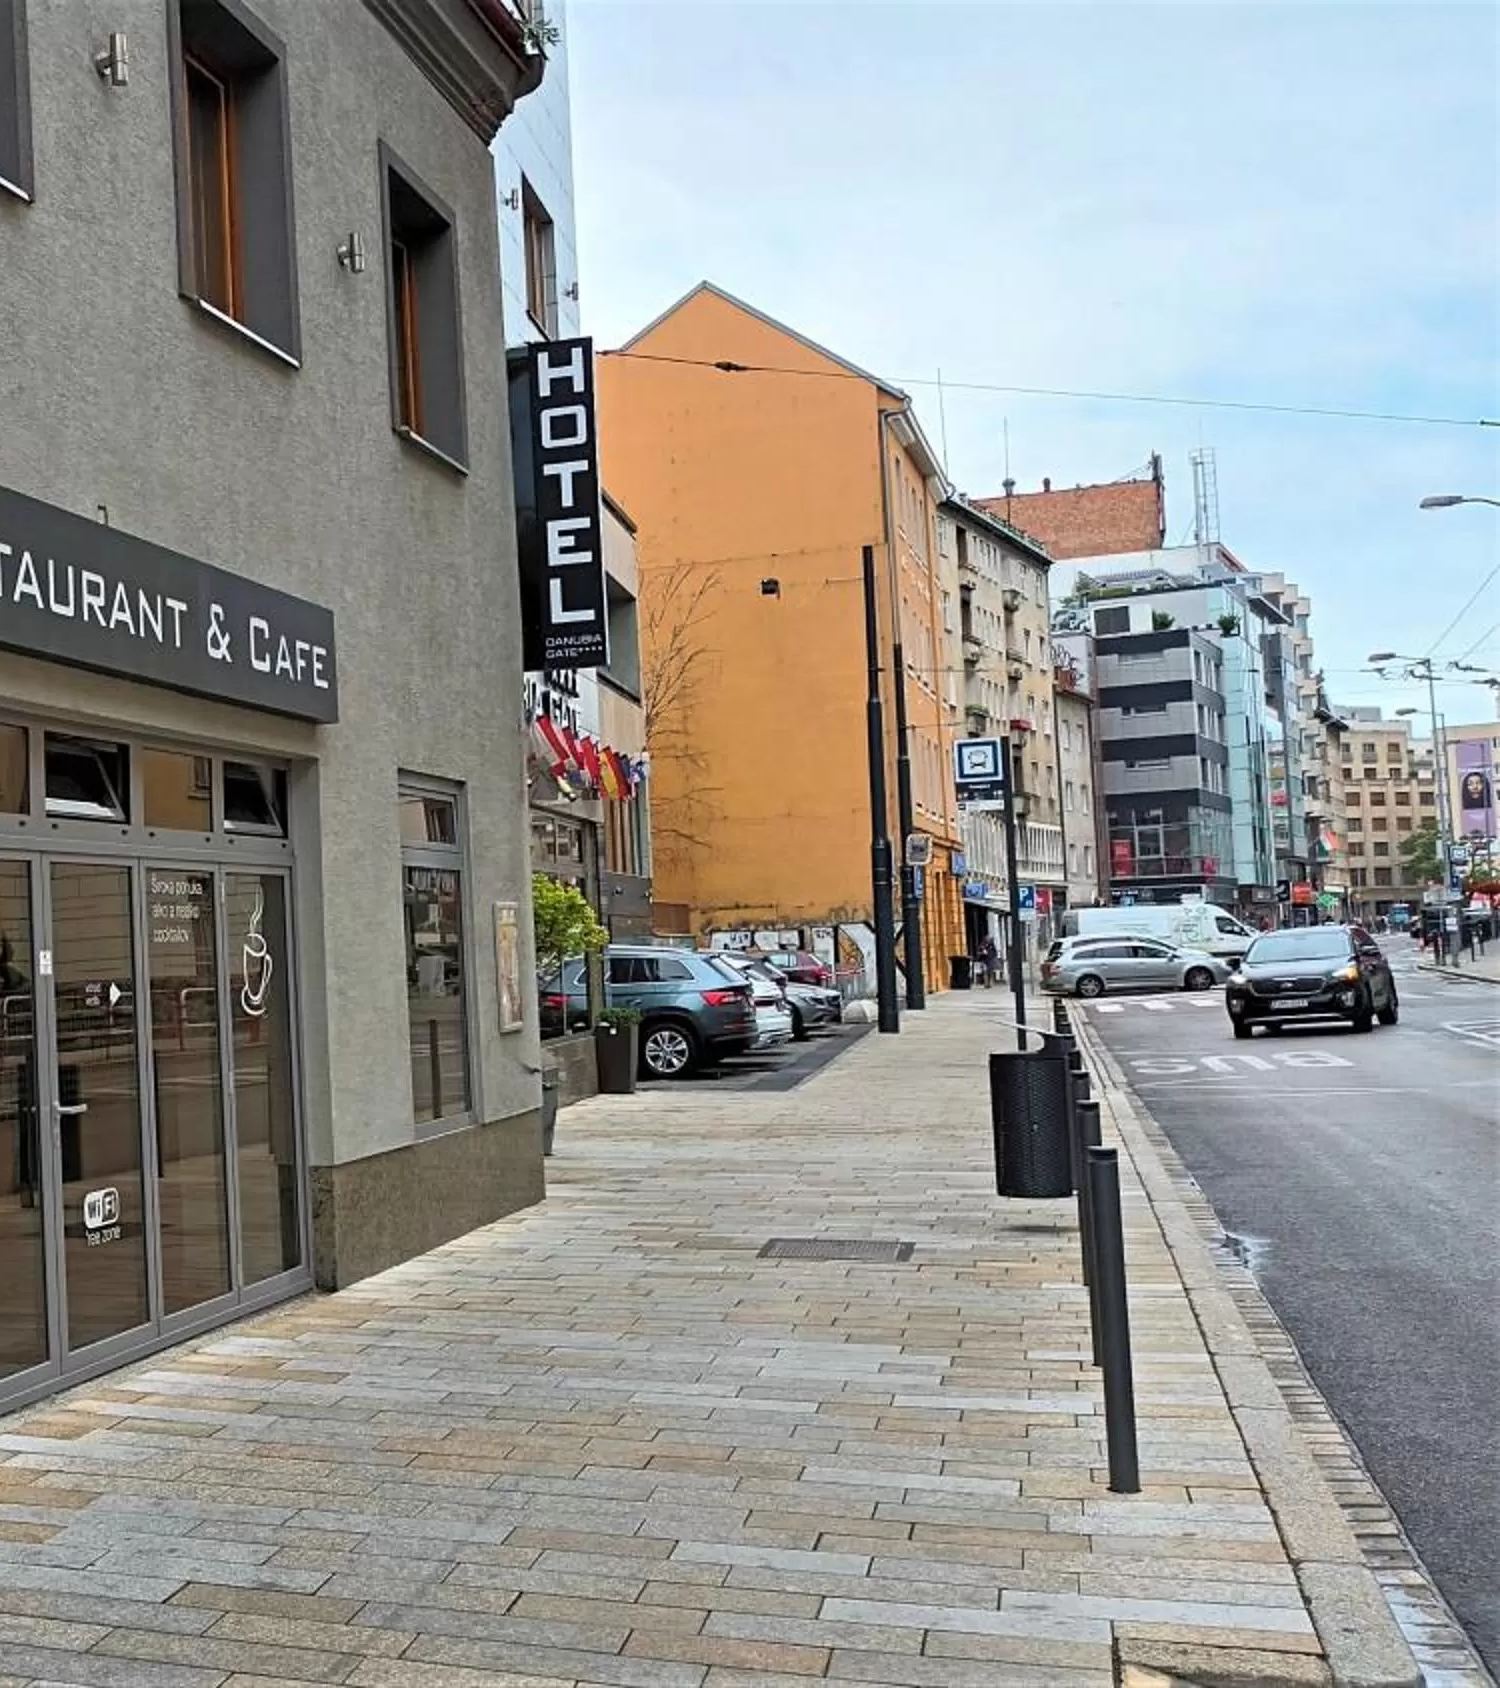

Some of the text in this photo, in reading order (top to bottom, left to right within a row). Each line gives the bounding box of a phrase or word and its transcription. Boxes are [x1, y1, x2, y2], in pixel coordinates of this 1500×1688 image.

[536, 346, 595, 624] HOTEL
[206, 603, 233, 662] &
[250, 616, 329, 689] CAFE
[545, 633, 602, 647] DANUBIA
[545, 647, 578, 659] GATE
[1129, 1050, 1355, 1074] BUS
